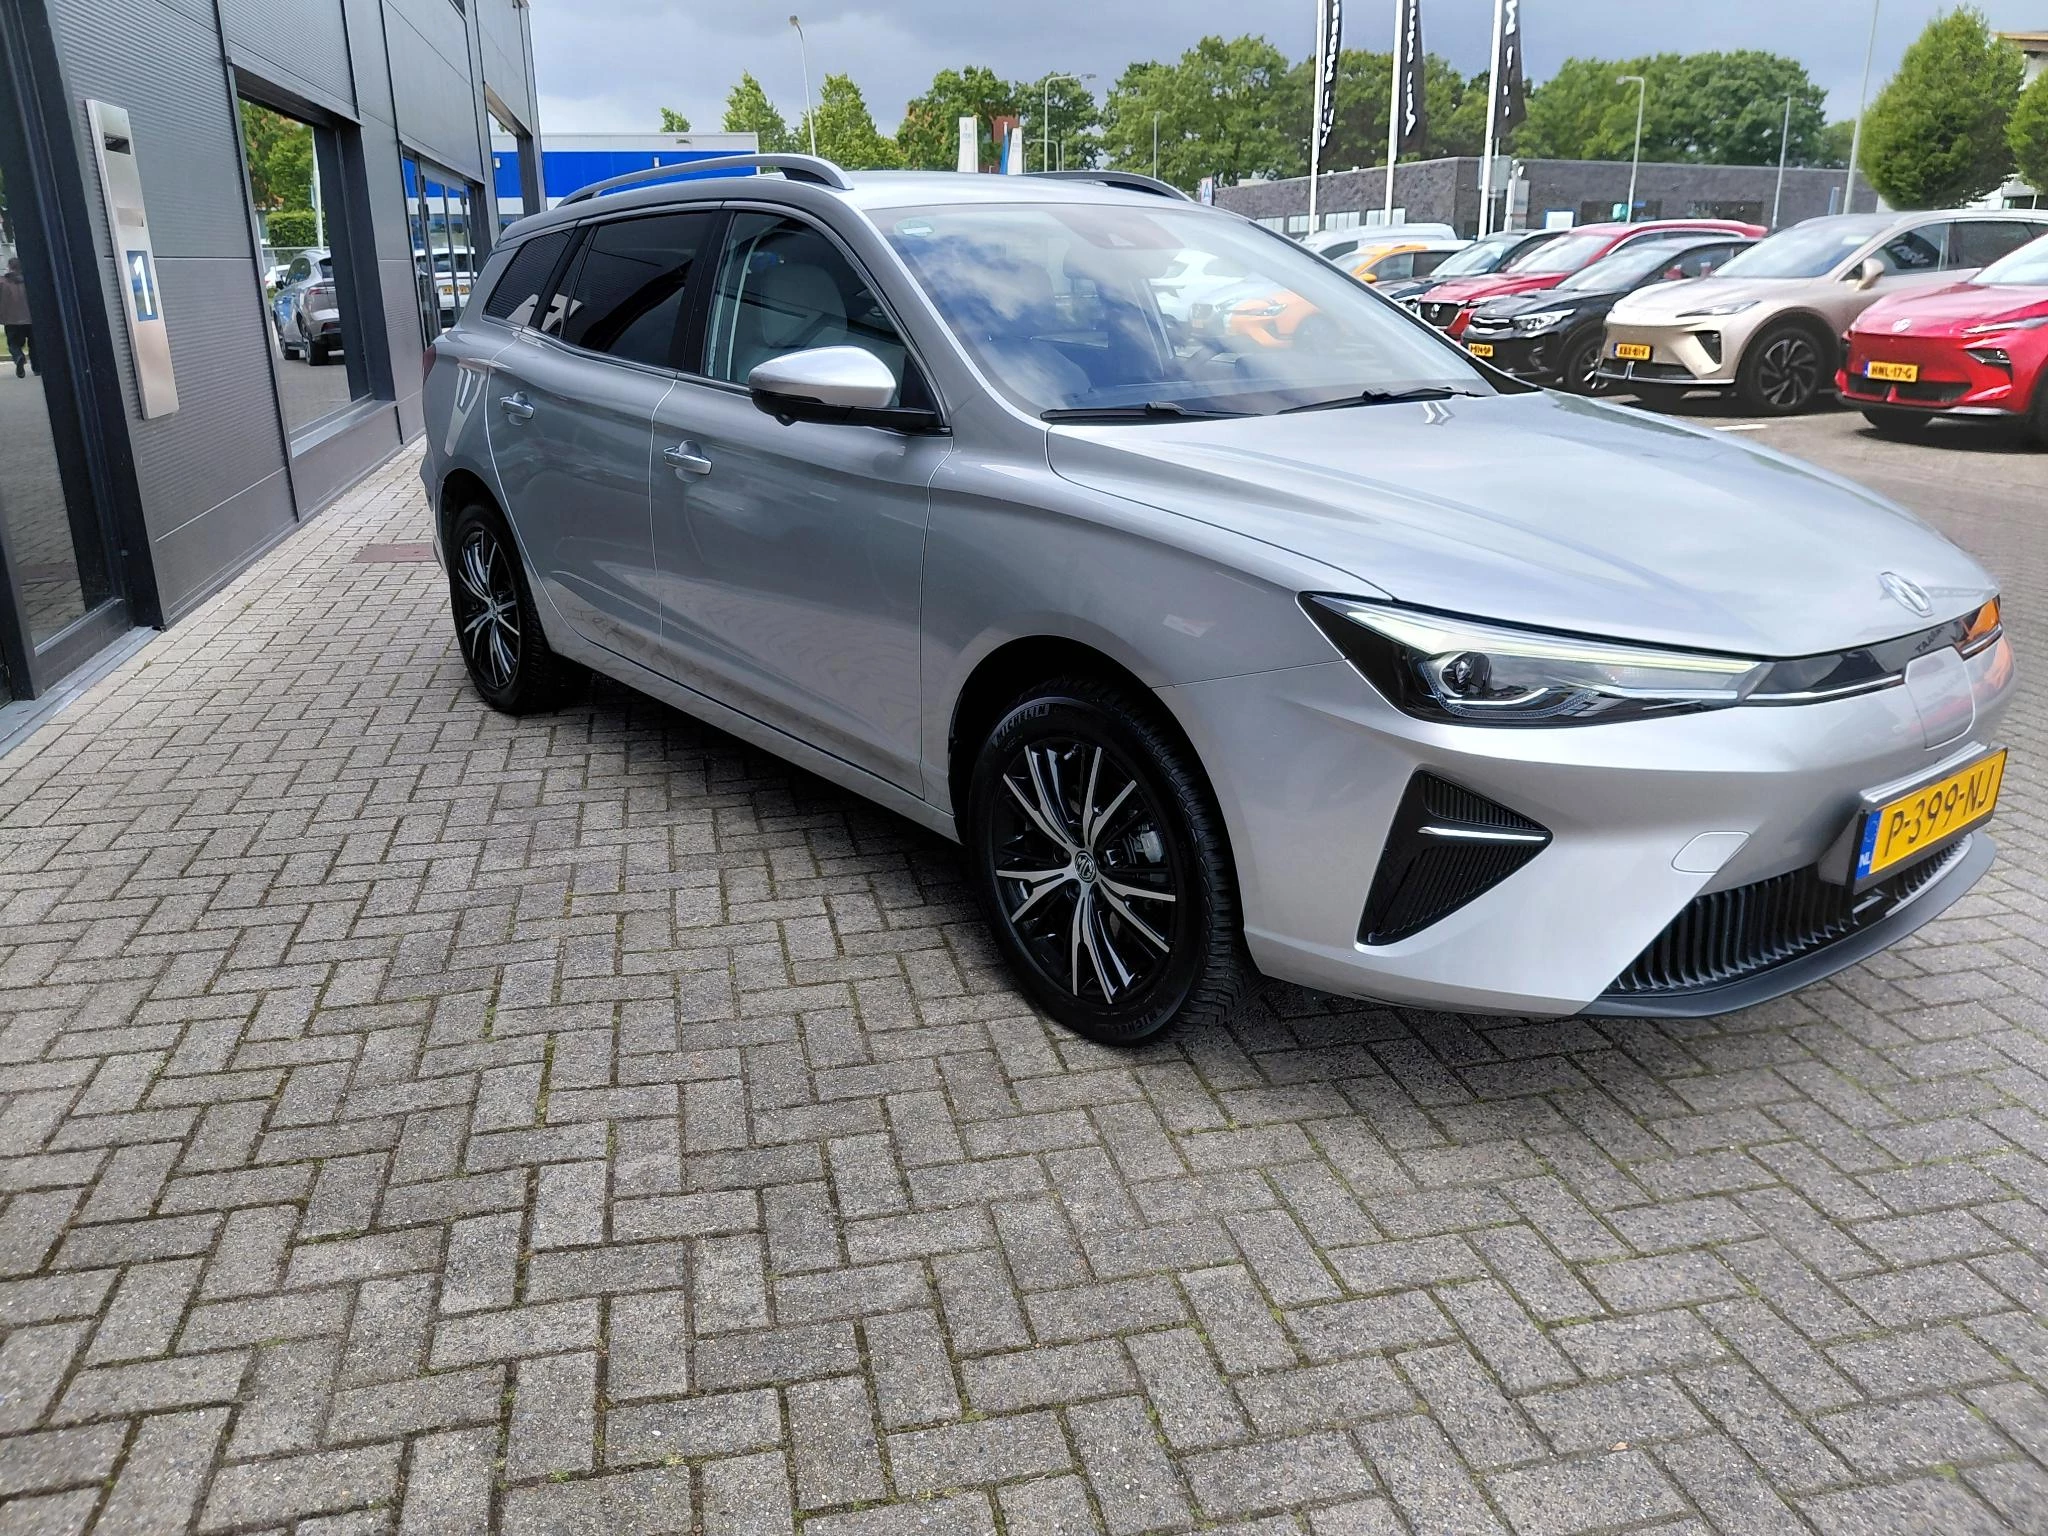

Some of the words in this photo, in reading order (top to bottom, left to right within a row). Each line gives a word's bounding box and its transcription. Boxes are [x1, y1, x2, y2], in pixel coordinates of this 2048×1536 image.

[133, 255, 153, 316] 1
[1885, 764, 1995, 858] P-399-NJ
[1858, 852, 1871, 869] NL
